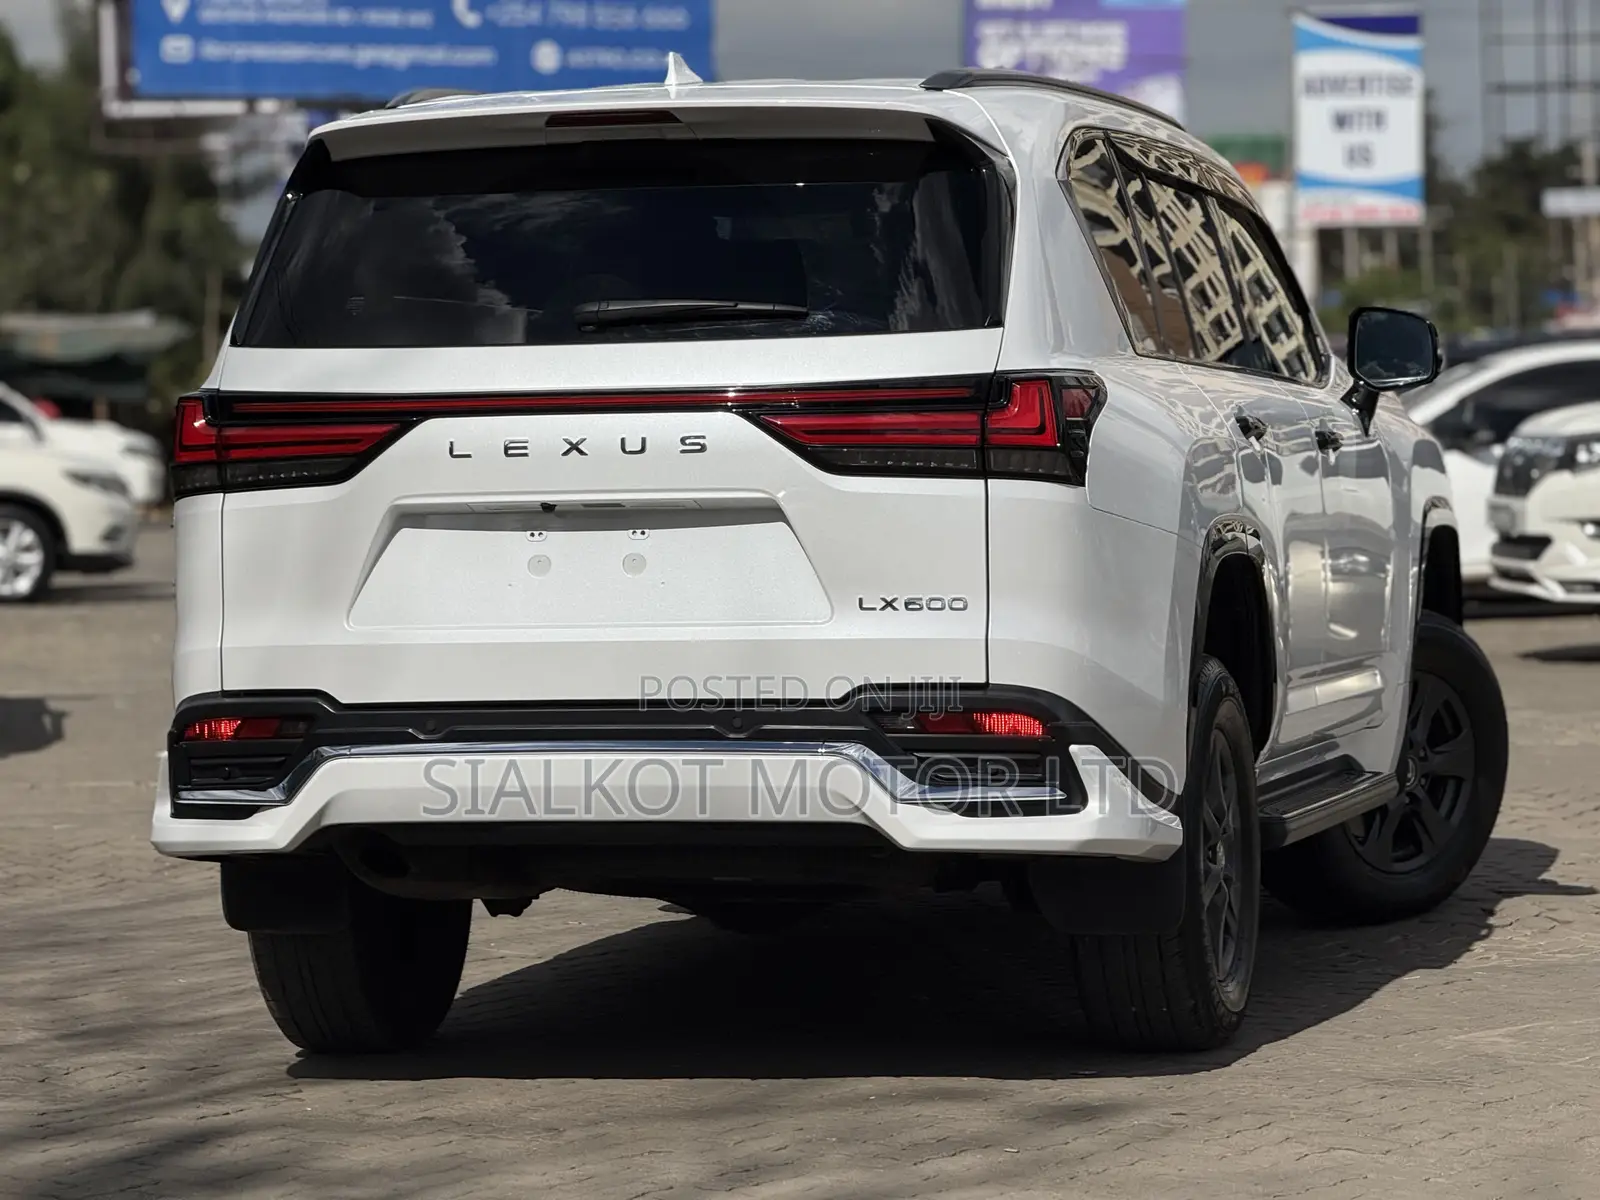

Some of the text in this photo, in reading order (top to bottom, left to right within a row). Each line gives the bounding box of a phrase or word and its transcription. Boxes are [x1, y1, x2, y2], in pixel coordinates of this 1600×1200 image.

[1303, 73, 1416, 97] ADVERTISE
[1331, 109, 1386, 132] WITH
[449, 435, 707, 458] LEXUS
[858, 597, 968, 611] LX600
